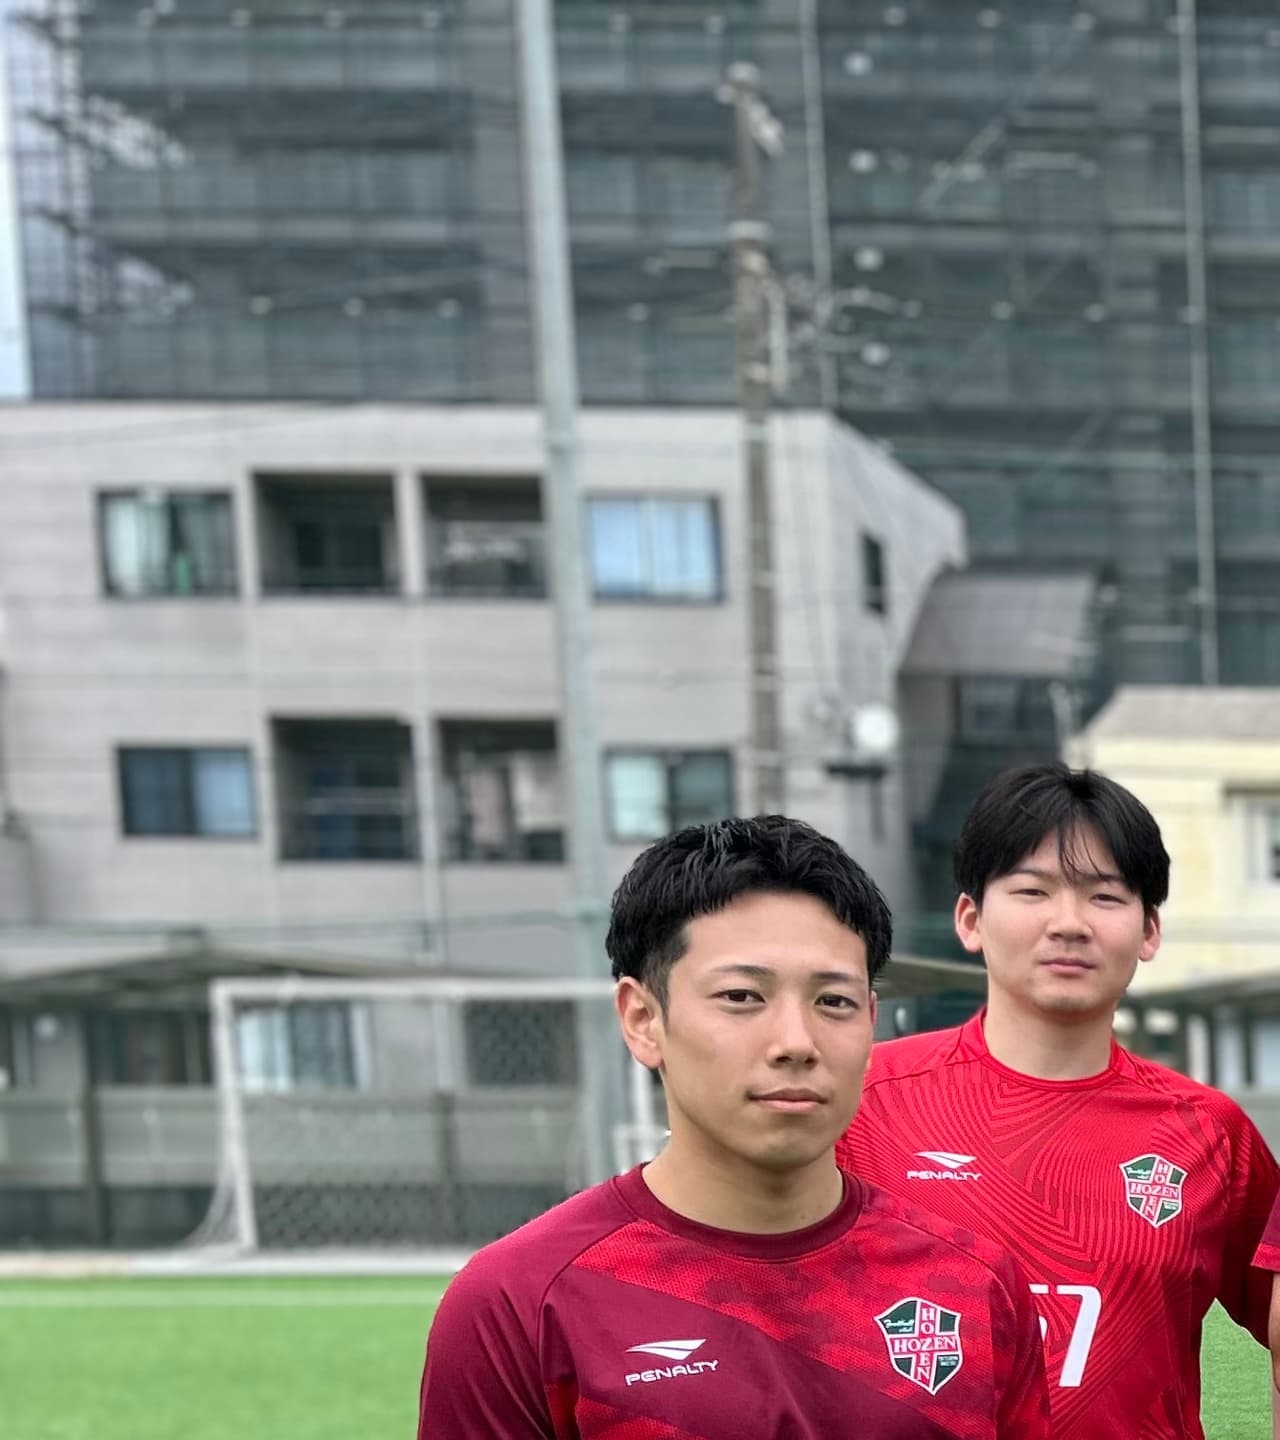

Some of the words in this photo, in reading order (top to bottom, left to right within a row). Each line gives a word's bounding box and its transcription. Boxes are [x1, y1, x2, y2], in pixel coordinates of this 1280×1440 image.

[906, 1169, 983, 1182] PENALTY
[1129, 1182, 1180, 1199] HOZEN
[893, 1336, 957, 1354] HOZEN
[625, 1359, 719, 1386] PENALTY
